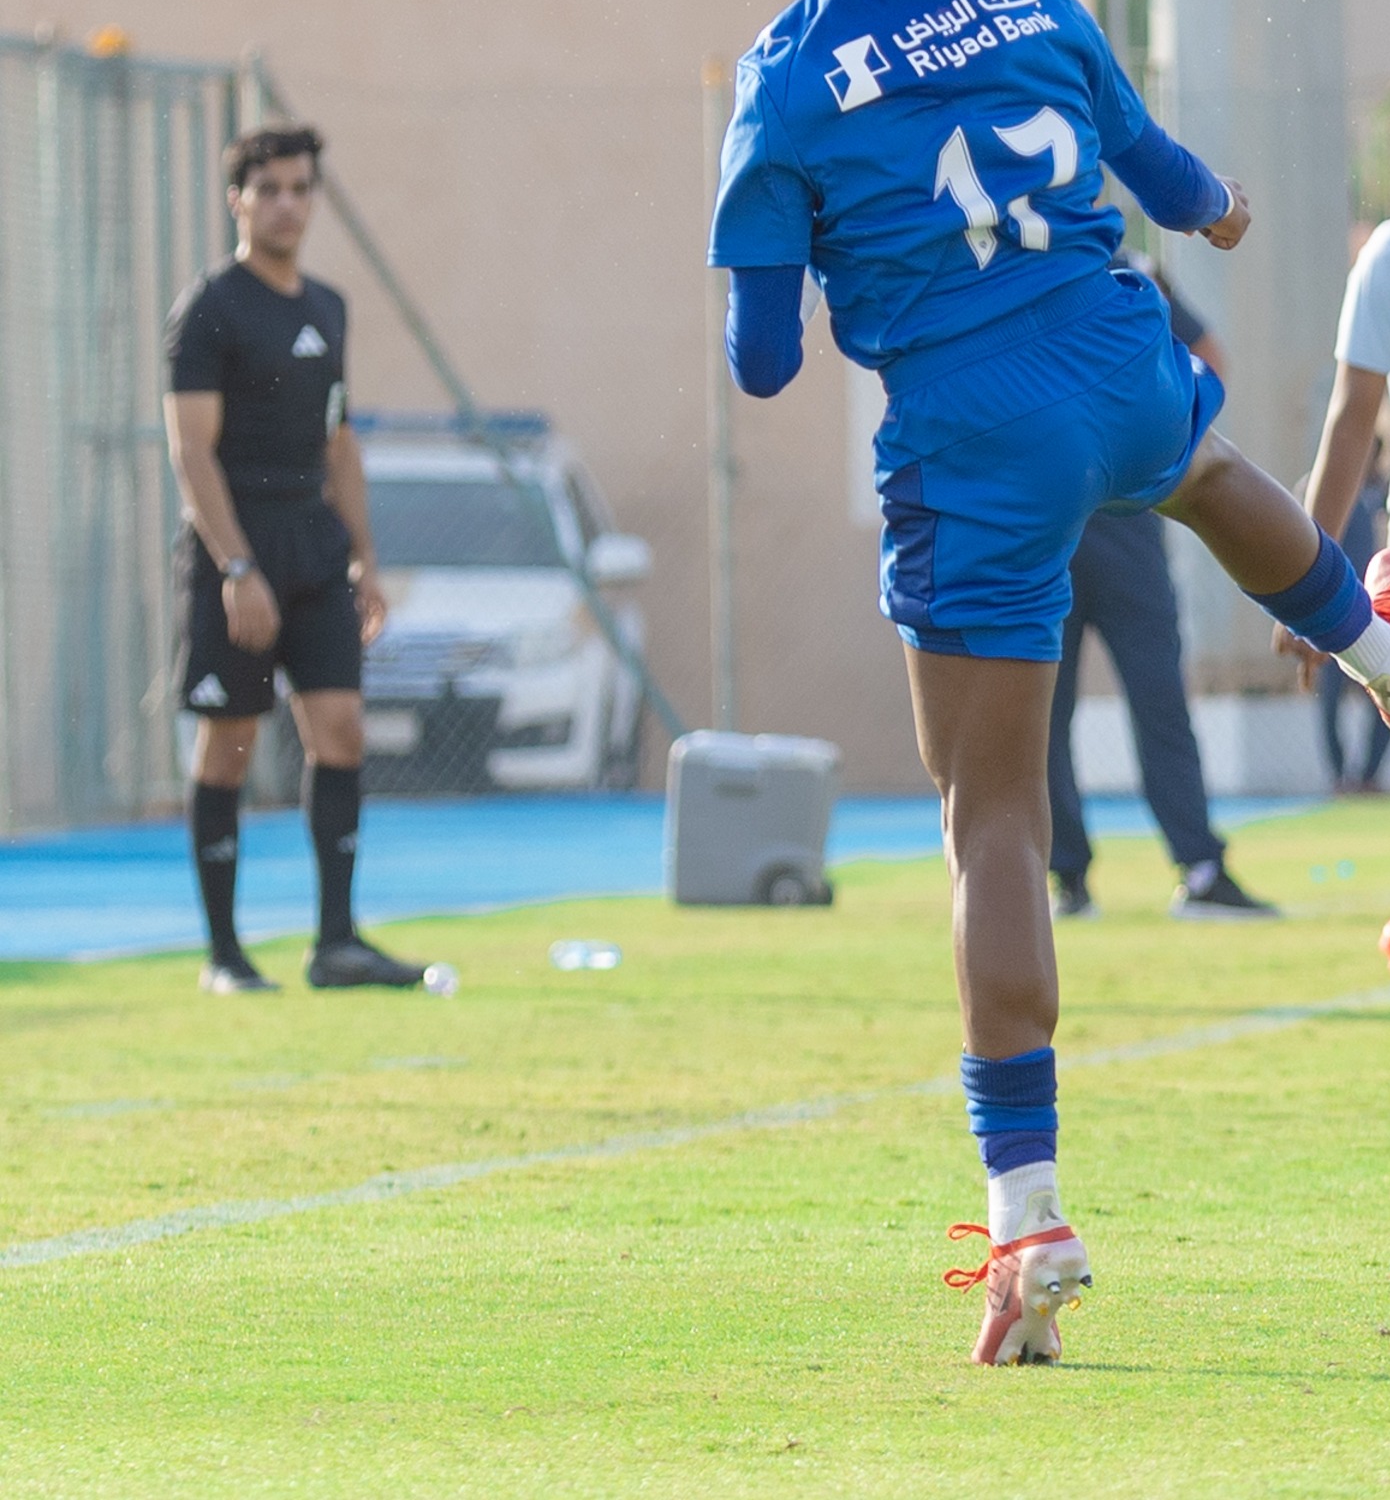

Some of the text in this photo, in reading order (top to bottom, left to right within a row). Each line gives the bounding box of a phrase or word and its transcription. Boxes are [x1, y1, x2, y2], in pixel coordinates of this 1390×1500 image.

[905, 10, 1059, 78] Riyad Bank
[933, 105, 1078, 271] 17
